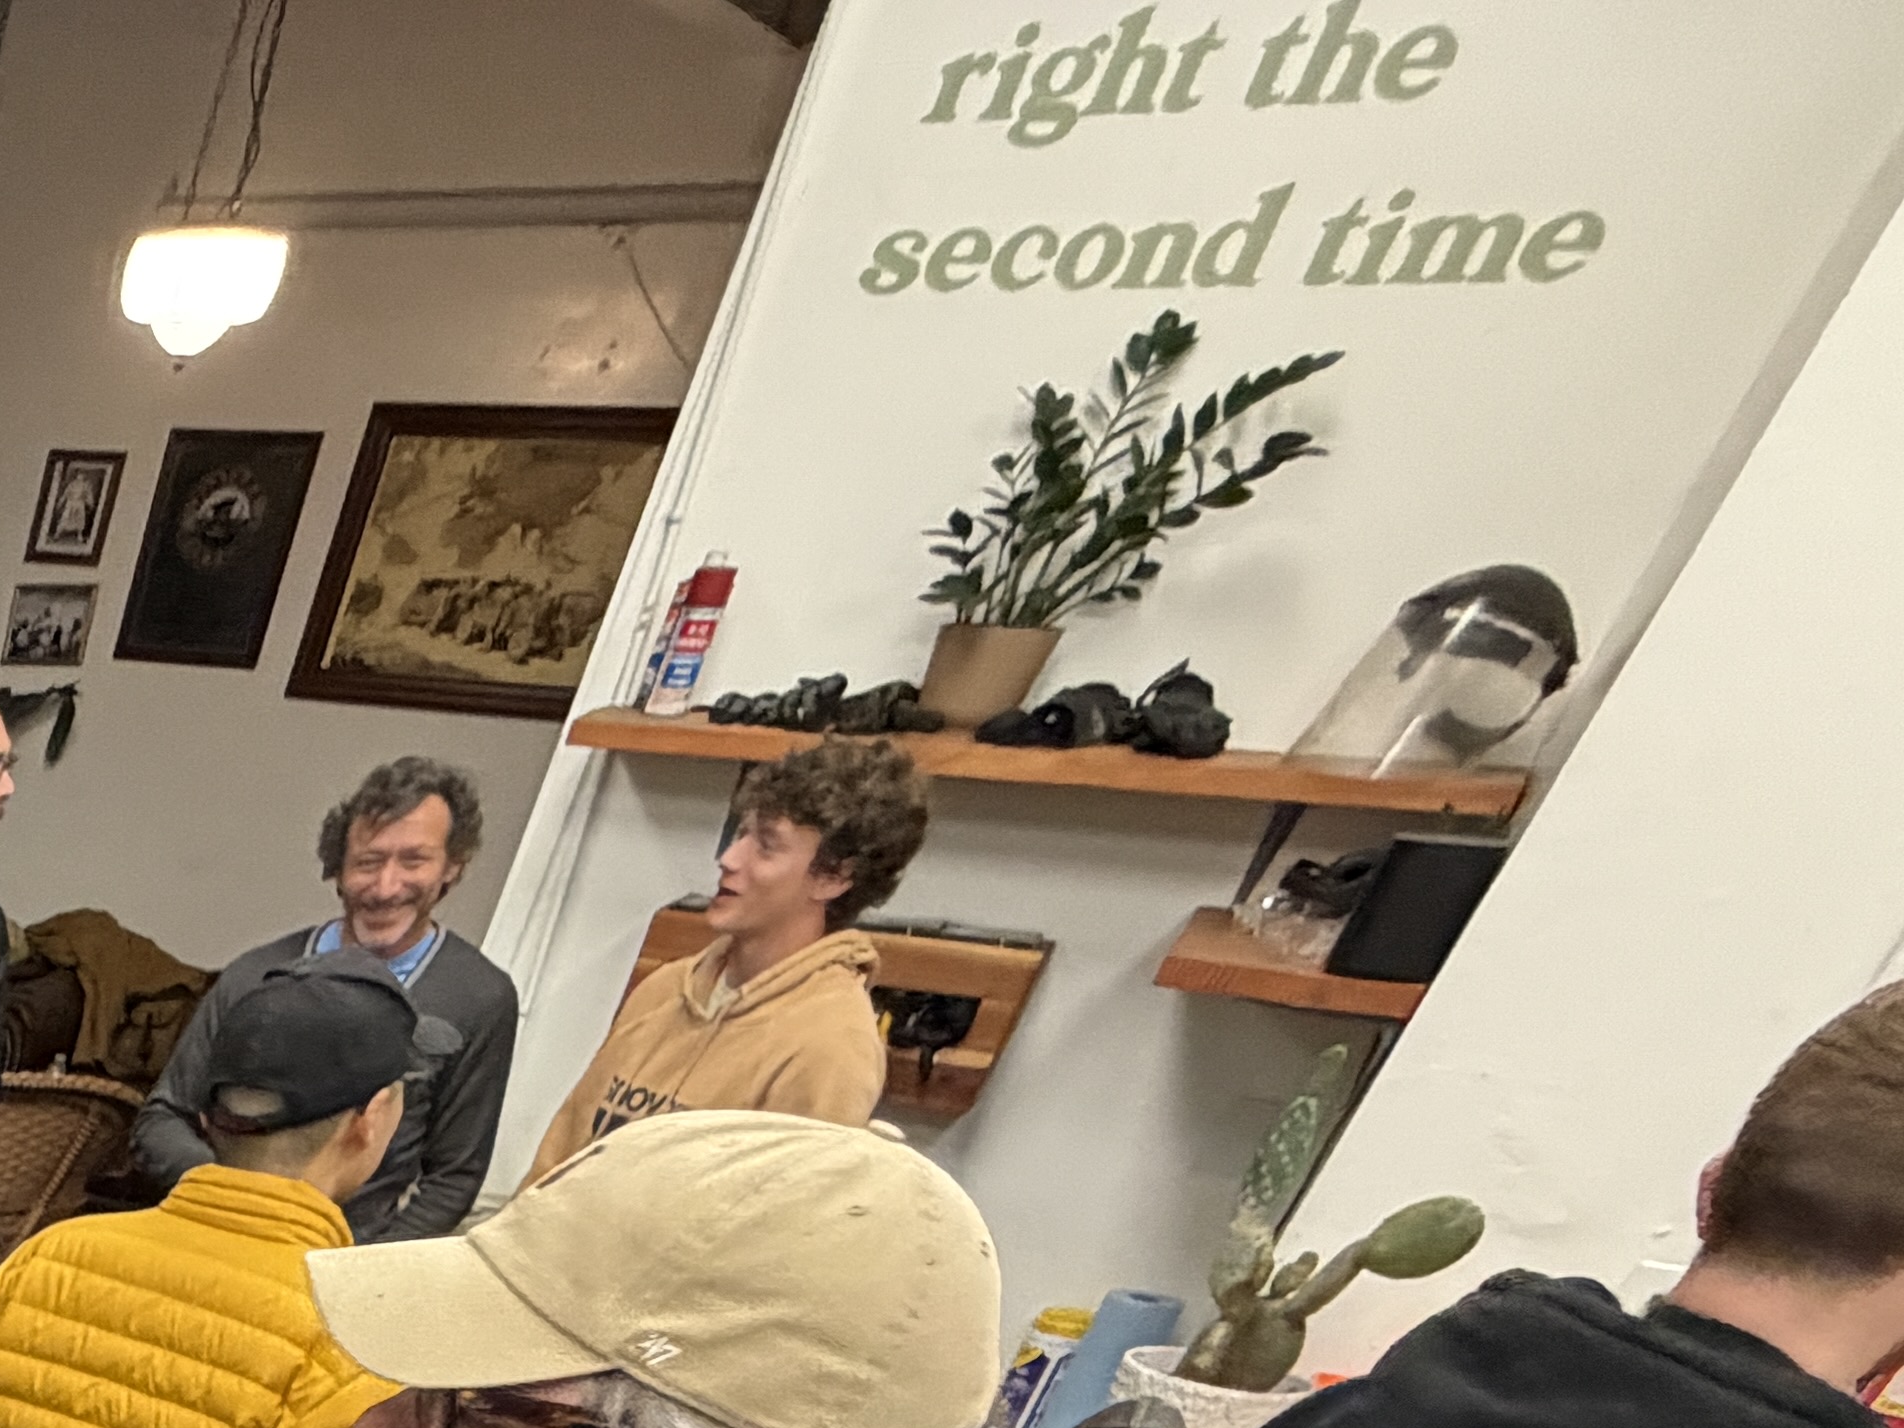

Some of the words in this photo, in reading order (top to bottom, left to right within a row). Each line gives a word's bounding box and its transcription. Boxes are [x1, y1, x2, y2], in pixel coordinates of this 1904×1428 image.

[920, 4, 1226, 148] right
[1242, 0, 1460, 109] the
[857, 182, 1297, 295] second
[1301, 188, 1607, 287] time
